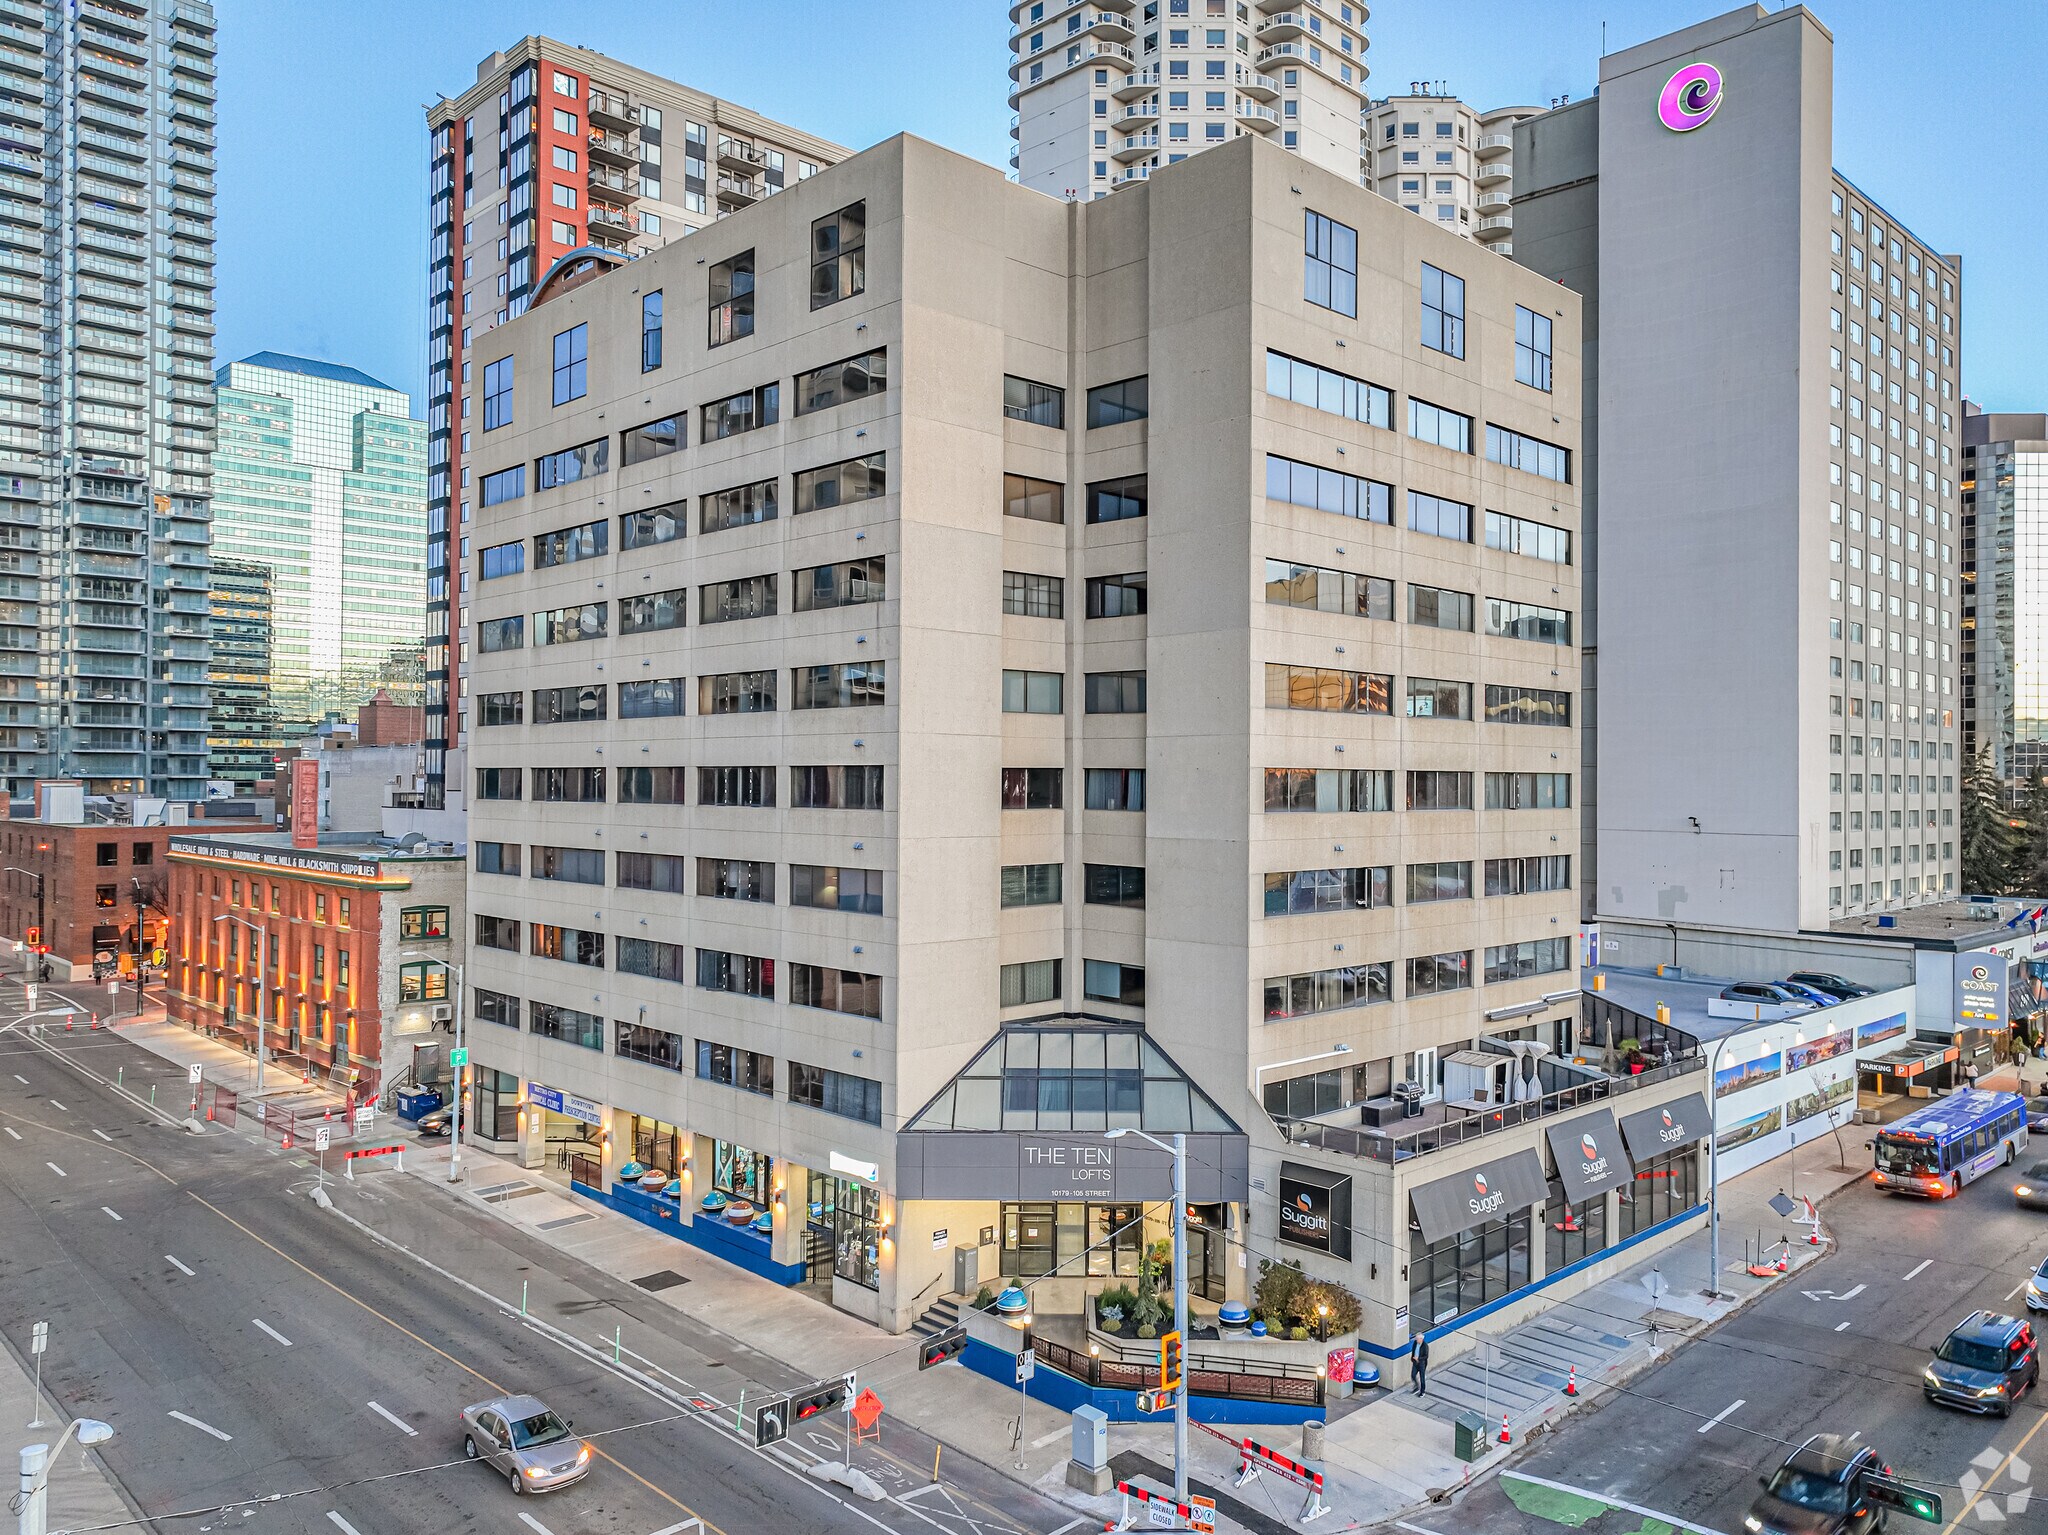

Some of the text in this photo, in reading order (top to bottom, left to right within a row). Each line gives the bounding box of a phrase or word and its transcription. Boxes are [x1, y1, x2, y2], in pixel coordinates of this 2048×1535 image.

[171, 842, 196, 854] WHOLESALE
[214, 848, 230, 859] STEEL
[232, 850, 261, 863] HARDWARE
[278, 856, 292, 867] MILL
[298, 858, 339, 873] BLACKSMITH
[1960, 979, 2000, 993] COAST
[1860, 1062, 1892, 1073] PARKING
[1660, 1124, 1686, 1143] Suggitt
[1024, 1147, 1111, 1165] THE TEN
[1071, 1168, 1111, 1181] LOFTS
[1582, 1157, 1608, 1175] Suggitt
[1469, 1190, 1505, 1215] Suggitt
[1281, 1206, 1327, 1231] Suggitt
[1267, 1464, 1283, 1476] POWER
[1150, 1501, 1175, 1517] SIDEWALK
[1153, 1512, 1172, 1526] CLOSED
